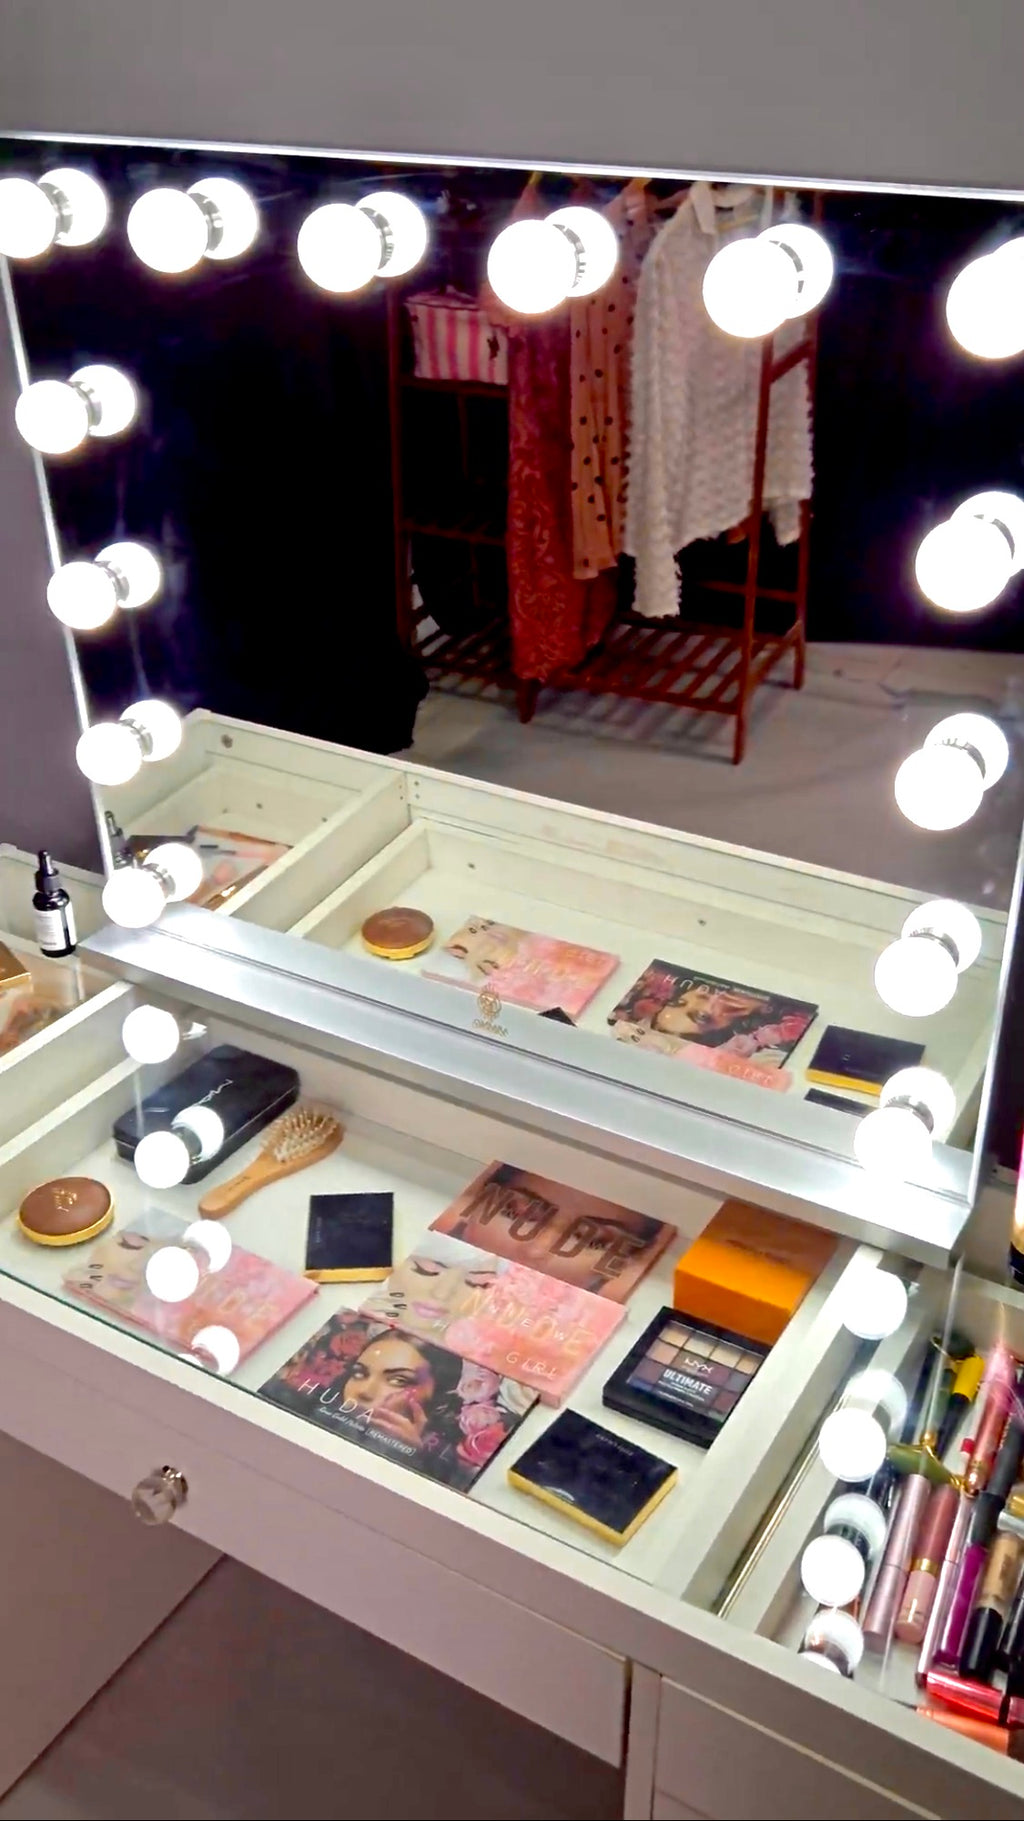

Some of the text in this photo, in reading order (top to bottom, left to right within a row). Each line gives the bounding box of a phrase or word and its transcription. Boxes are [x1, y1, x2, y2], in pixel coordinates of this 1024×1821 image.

[459, 1181, 646, 1280] NUDE
[506, 1351, 557, 1378] GIRL
[684, 1357, 714, 1374] NYX
[663, 1368, 713, 1396] ULTIMATE
[297, 1378, 374, 1424] HUDA
